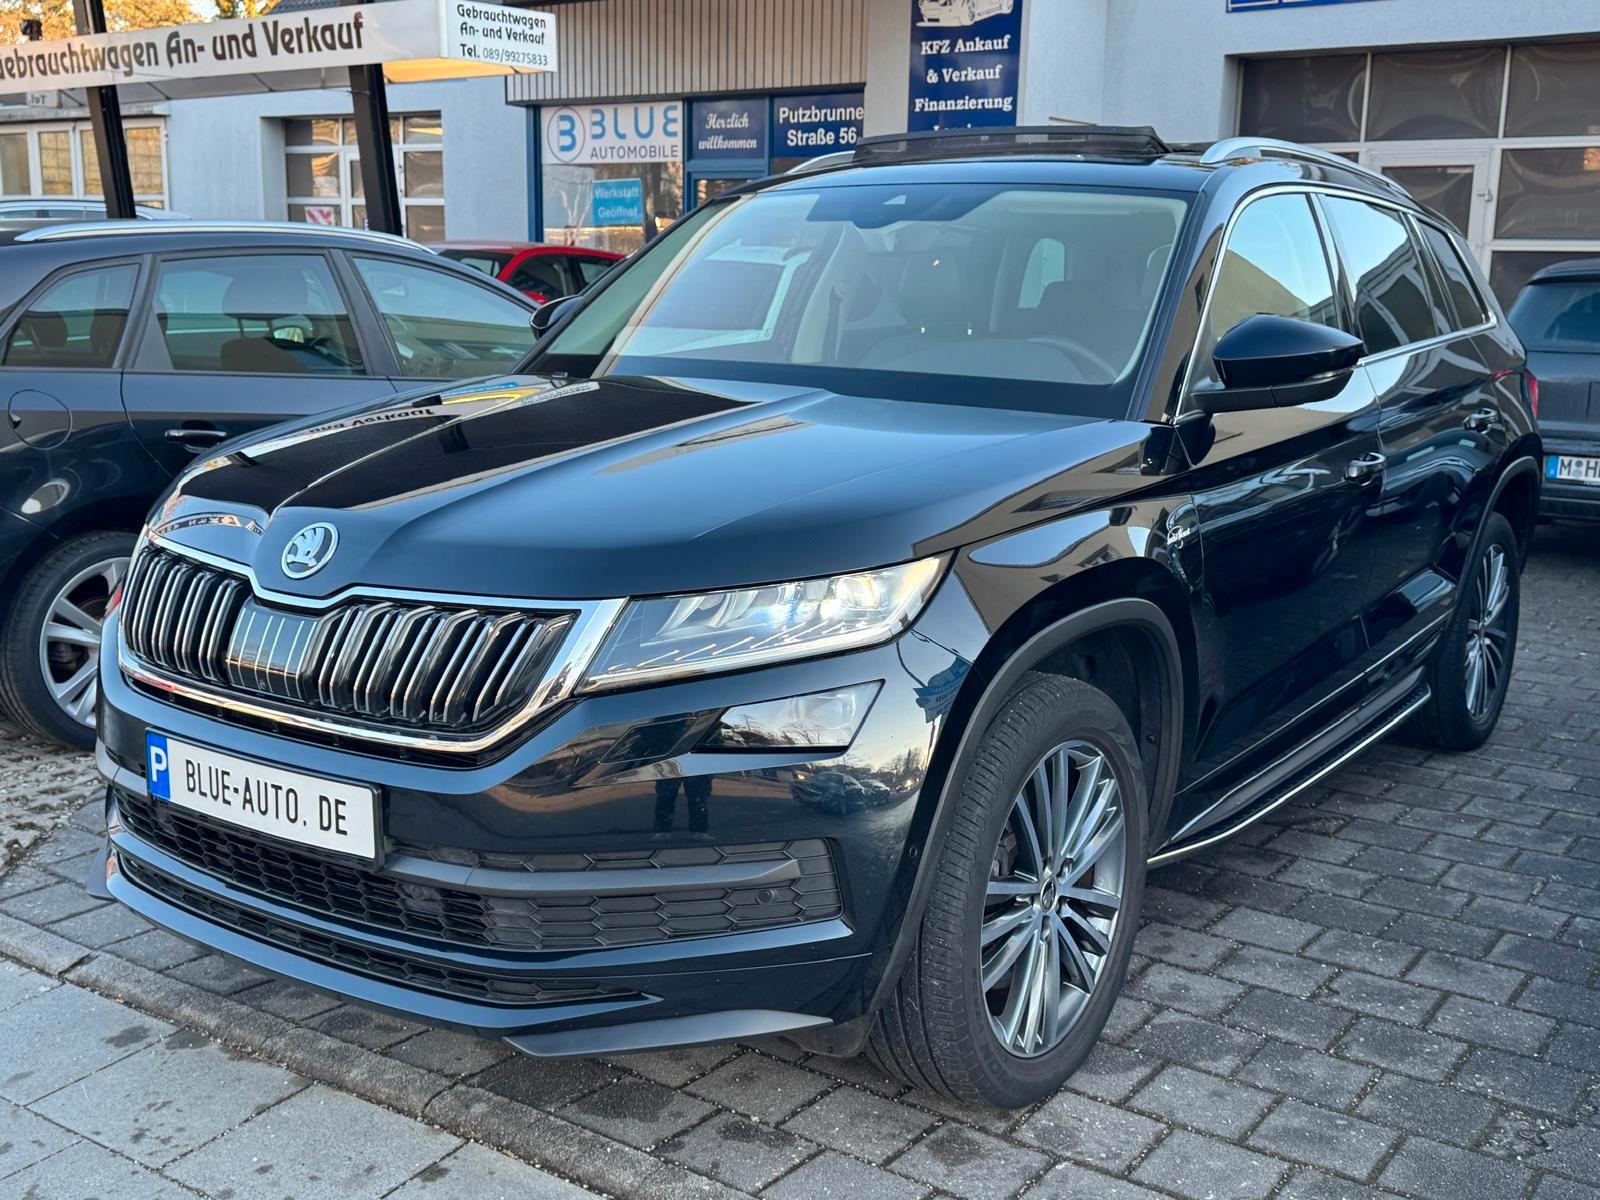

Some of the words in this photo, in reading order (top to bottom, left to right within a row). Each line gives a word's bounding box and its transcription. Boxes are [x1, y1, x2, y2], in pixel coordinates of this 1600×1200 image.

[457, 4, 546, 30] Gebrauchtwagen
[166, 31, 205, 68] An-
[212, 24, 257, 60] und
[261, 11, 364, 56] Verkauf
[460, 22, 480, 36] An-
[482, 25, 502, 39] und
[505, 27, 545, 45] Verkauf
[460, 43, 480, 58] Tel.
[483, 47, 548, 66] 089/99275833
[921, 39, 951, 55] KFZ
[954, 34, 1011, 53] Ankauf
[926, 69, 939, 84] &
[942, 64, 1002, 83] Verkauf
[914, 95, 1013, 112] Finanzierung
[591, 105, 678, 140] BLUE
[705, 112, 749, 130] Herzlich
[698, 135, 758, 150] willkommen
[787, 129, 835, 147] Straße
[839, 127, 858, 145] 56
[590, 145, 679, 159] AUTOMOBILE
[594, 187, 640, 199] Werkstatt
[1559, 458, 1573, 476] M
[150, 745, 167, 783] P
